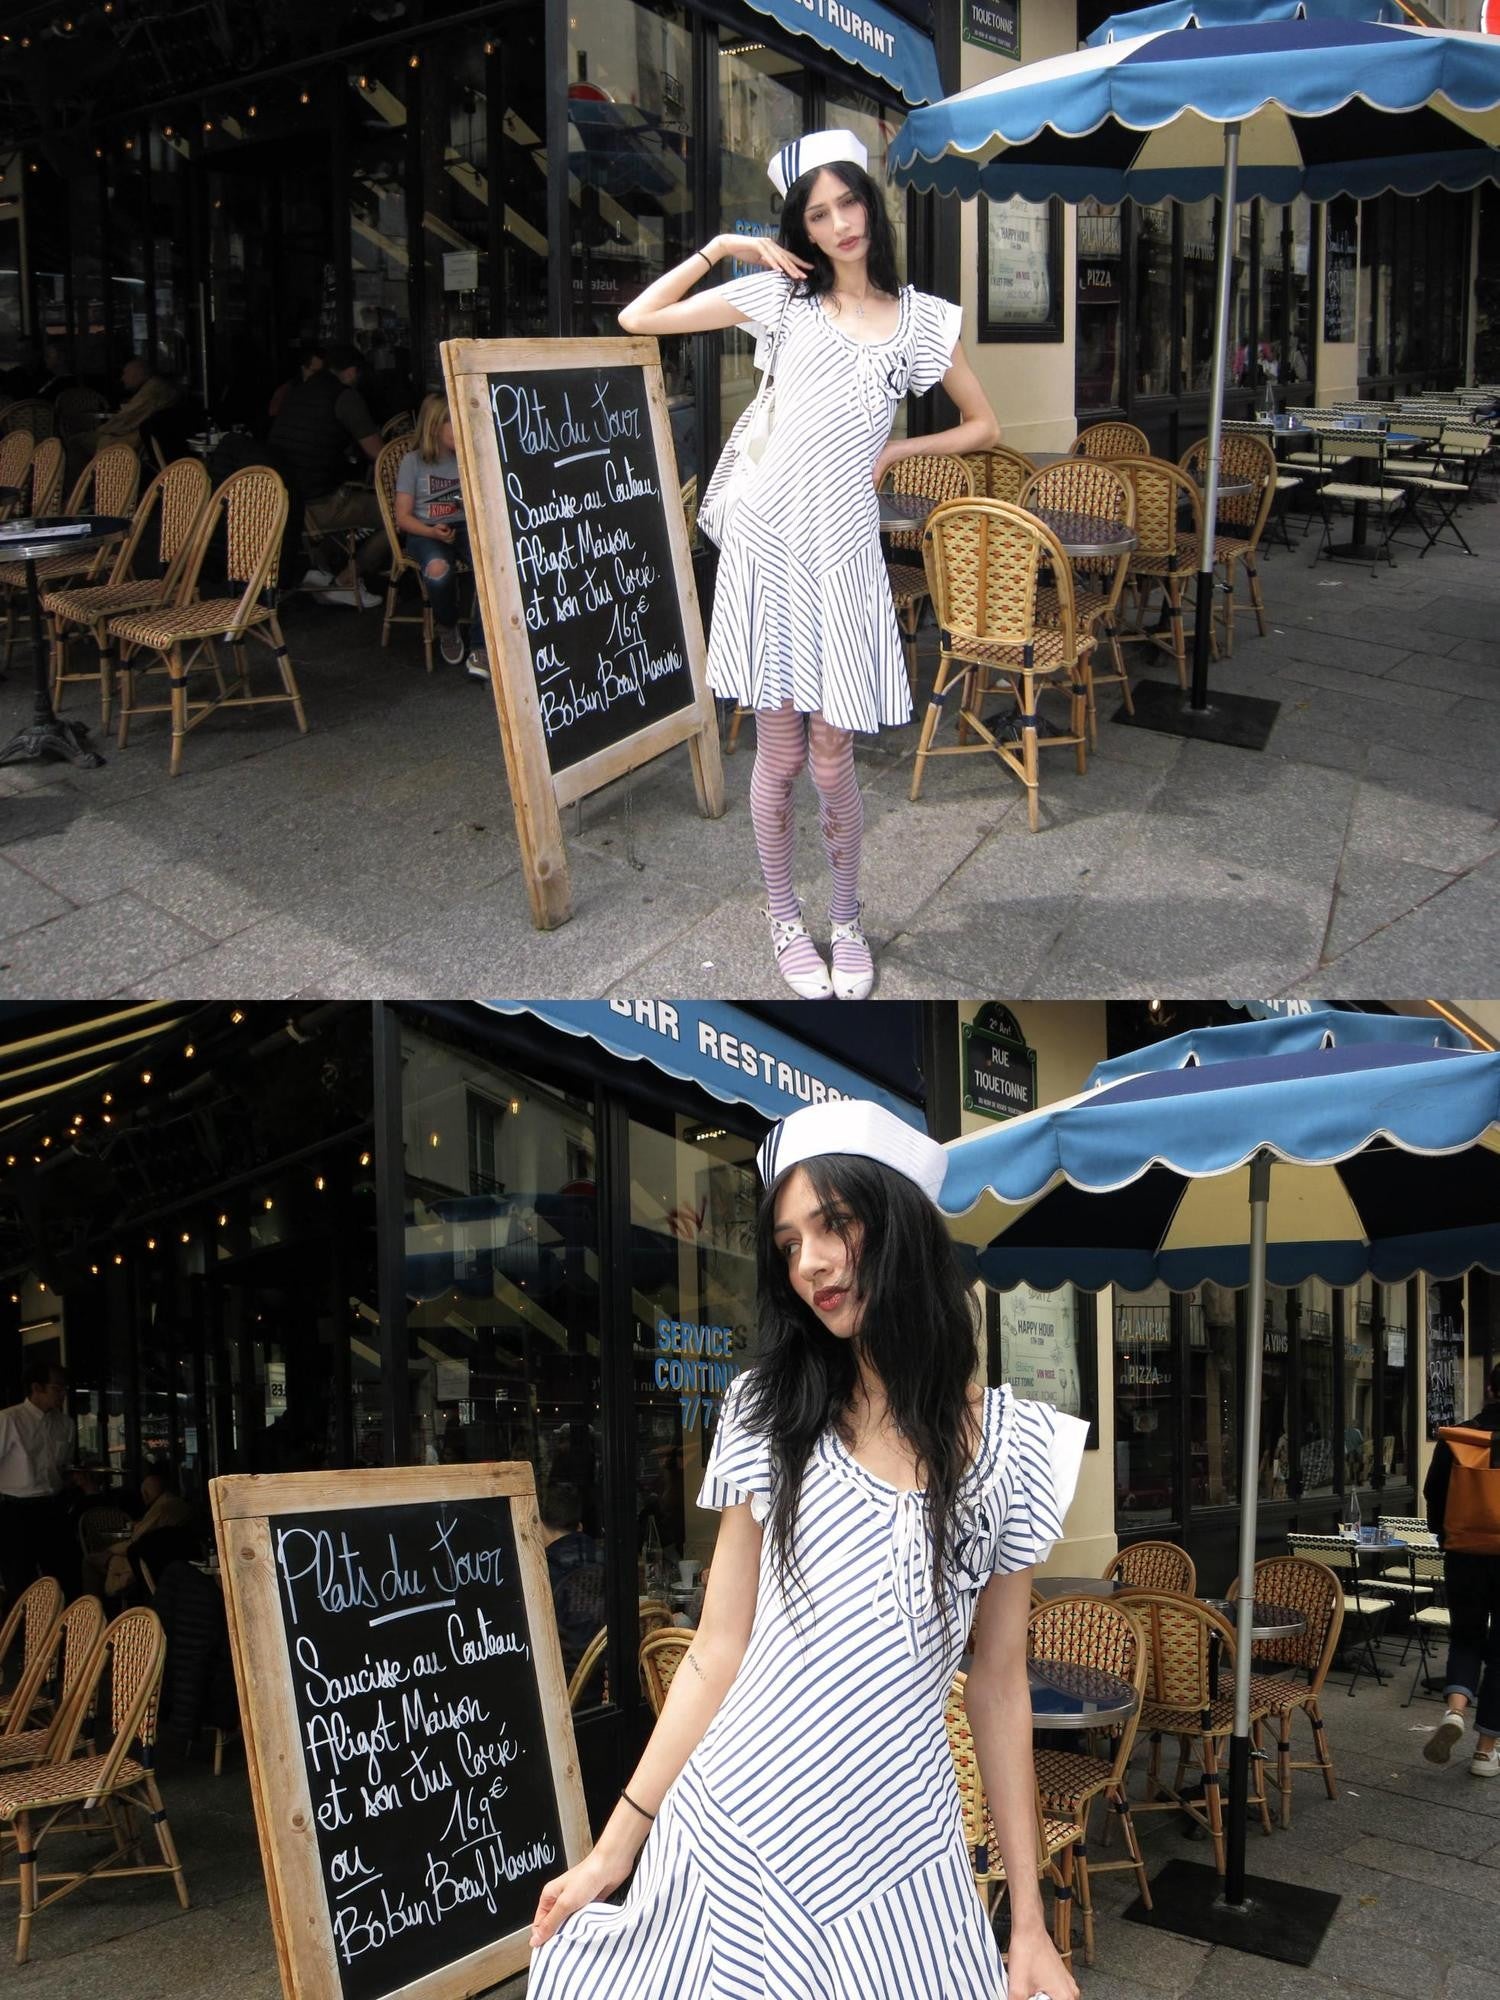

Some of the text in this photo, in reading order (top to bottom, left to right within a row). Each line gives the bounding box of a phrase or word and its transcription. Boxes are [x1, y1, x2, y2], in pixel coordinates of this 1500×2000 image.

[972, 5, 1014, 36] TIQUETONNE
[1087, 269, 1112, 288] PIZZA
[490, 381, 642, 463] Plats du Jour
[431, 503, 452, 517] KIND
[507, 472, 582, 531] Saucisse
[583, 491, 607, 510] au
[516, 519, 636, 597] Aligot Maison
[525, 588, 550, 631] et
[556, 595, 582, 623] son
[579, 567, 614, 612] Jus
[536, 643, 566, 672] ou
[991, 1046, 1010, 1067] RUE
[974, 1069, 1029, 1103] TIQUETONNE
[657, 1318, 733, 1358] SERVICE
[1017, 1319, 1055, 1338] HAPPY HOUR
[1121, 1319, 1169, 1342] PLANCHA
[1129, 1366, 1160, 1385] PIZZA
[277, 1517, 504, 1624] Plats du Jour
[296, 1607, 530, 1708] Saucisse au Couteau,
[306, 1687, 490, 1786] Aligot Maison
[317, 1778, 353, 1831] et
[360, 1783, 403, 1818] son
[401, 1746, 452, 1802] Jus
[330, 1845, 375, 1883] ou
